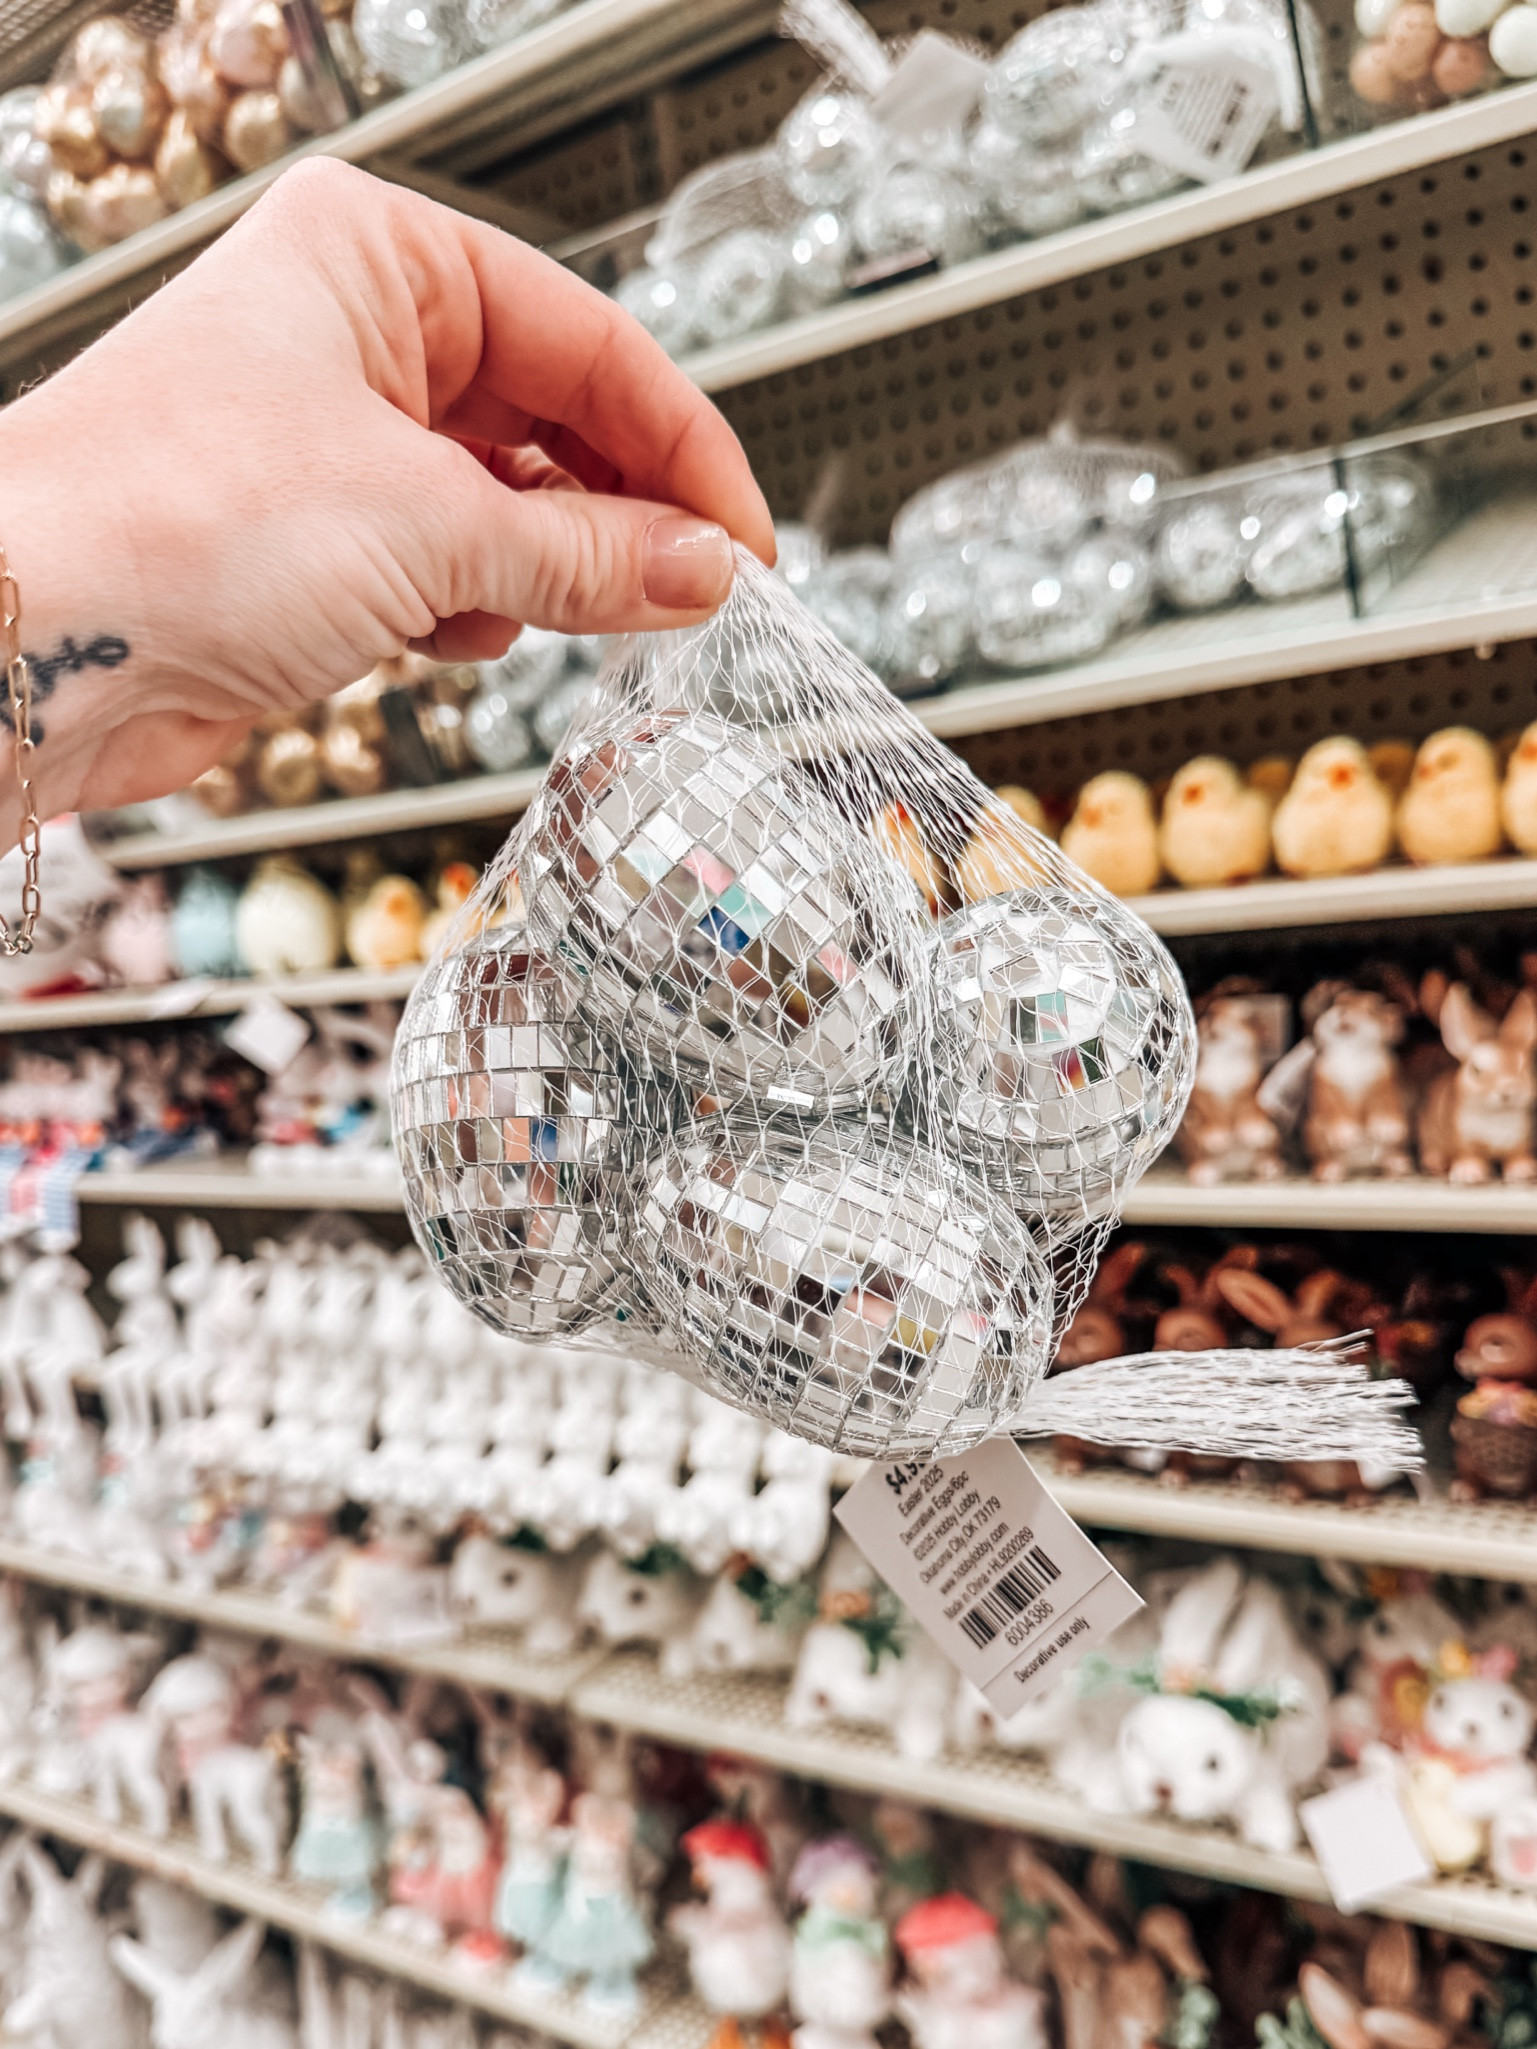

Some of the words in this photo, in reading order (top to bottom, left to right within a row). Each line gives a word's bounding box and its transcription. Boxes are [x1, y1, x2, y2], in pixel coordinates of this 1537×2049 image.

[885, 1462, 925, 1495] $4.9
[897, 1487, 923, 1518] Easter
[919, 1463, 944, 1493] 2025
[899, 1507, 936, 1546] Decorative
[919, 1549, 954, 1584] Oklahoma
[973, 1495, 1001, 1526] 73179
[932, 1512, 959, 1540] Hobby
[952, 1488, 981, 1518] Lobby
[942, 1597, 965, 1620] Made
[965, 1571, 990, 1597] China
[987, 1525, 1034, 1573] HL9200269
[1004, 1598, 1054, 1647] 6004386
[1012, 1643, 1058, 1684] Decorative
[1054, 1630, 1073, 1649] use
[1069, 1614, 1091, 1636] only
